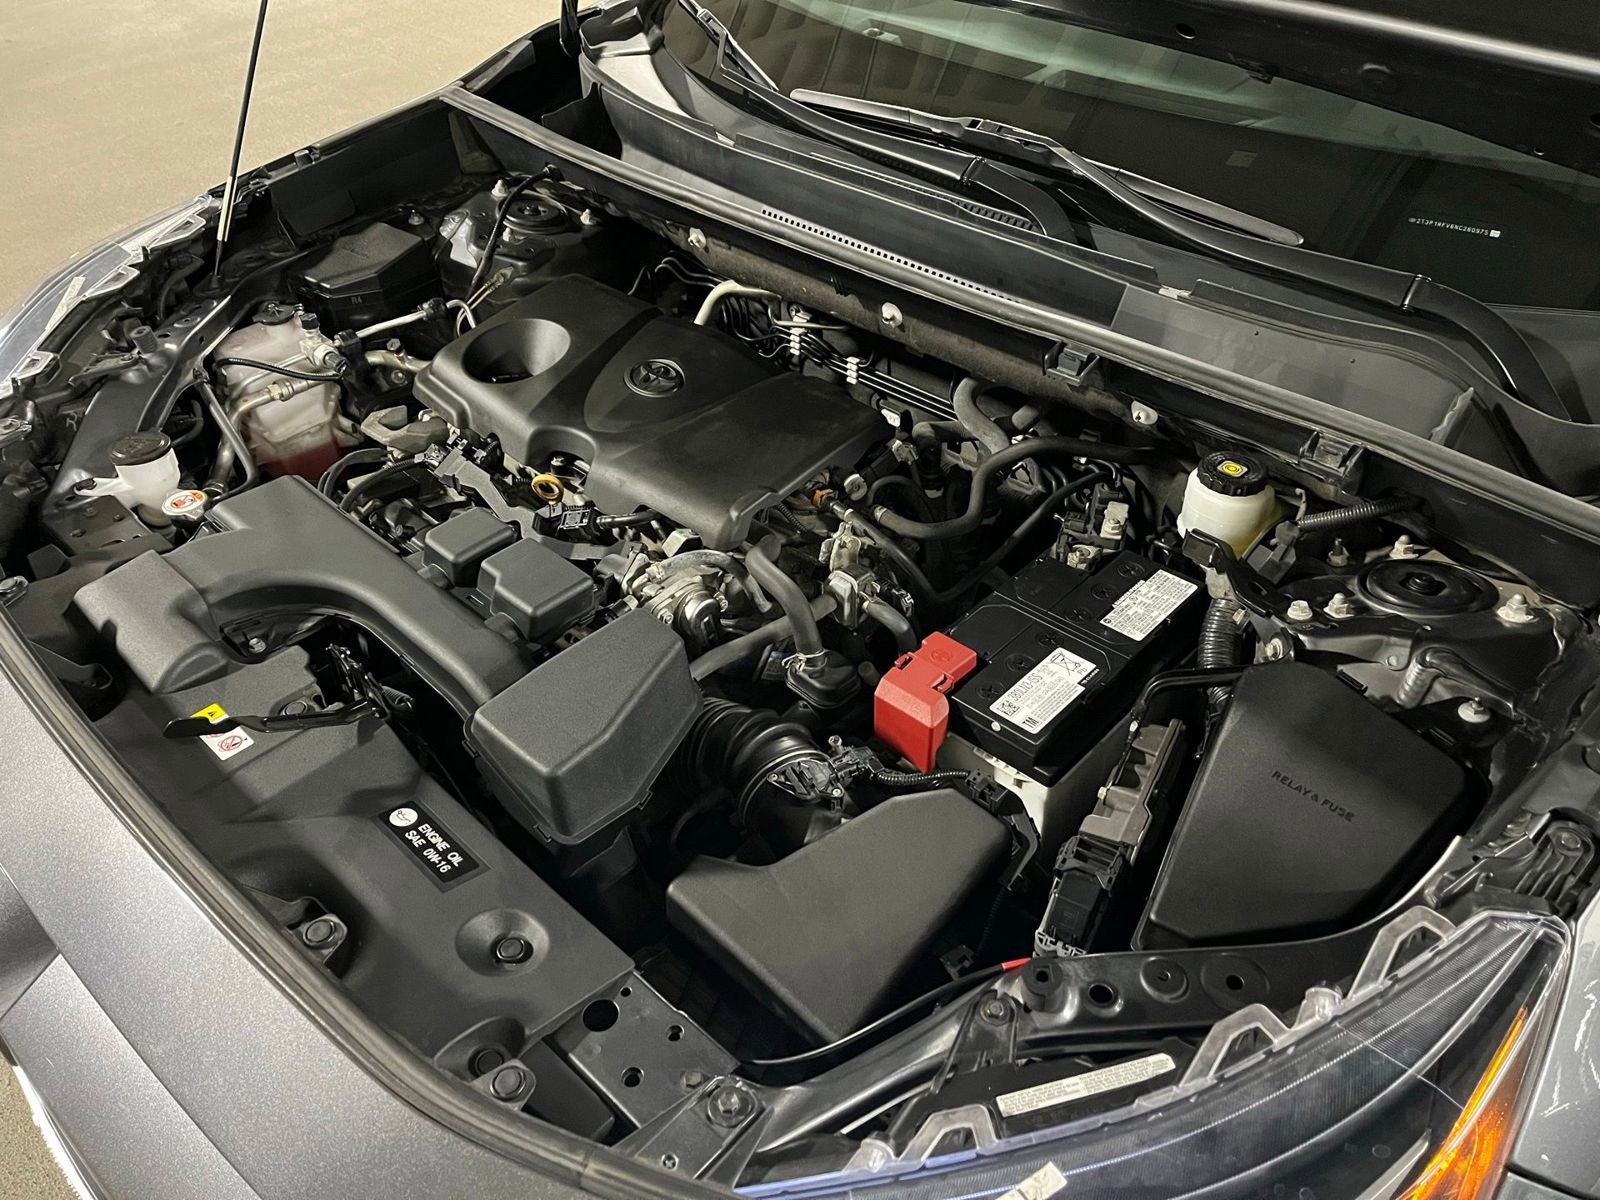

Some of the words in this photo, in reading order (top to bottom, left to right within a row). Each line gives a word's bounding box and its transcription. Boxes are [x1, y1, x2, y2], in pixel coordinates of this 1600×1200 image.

[1271, 770, 1312, 797] RELAY
[1321, 799, 1355, 822] FUSE
[405, 830, 426, 848] SAE
[423, 848, 451, 873] 0W-16
[418, 823, 450, 852] ENGINE
[447, 851, 463, 867] OIL
